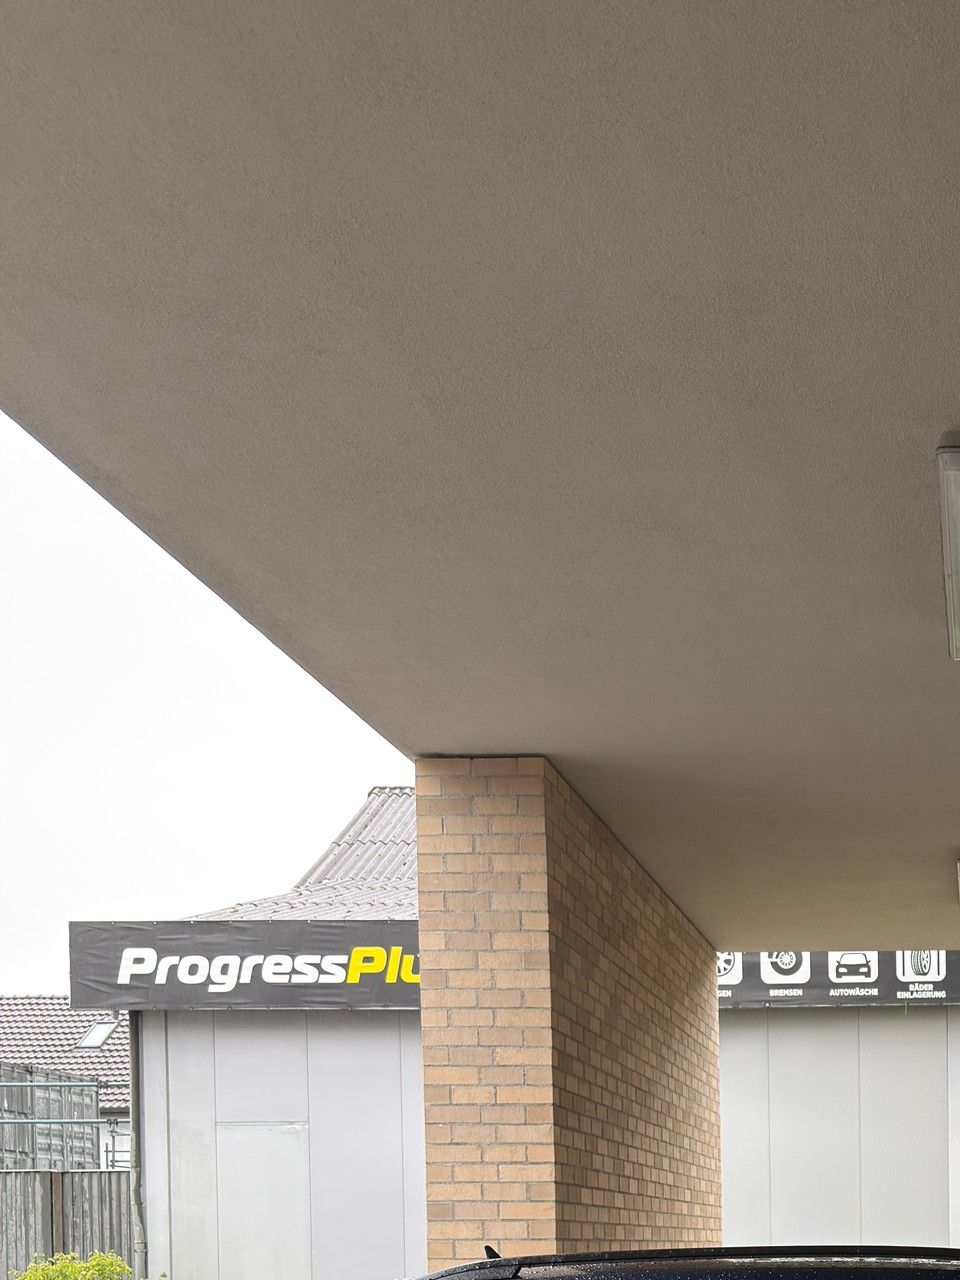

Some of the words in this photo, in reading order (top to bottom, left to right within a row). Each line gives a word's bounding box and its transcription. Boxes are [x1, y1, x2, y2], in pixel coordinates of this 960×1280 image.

[117, 946, 421, 993] ProgressPlu
[909, 983, 934, 991] RÄDER
[718, 989, 732, 998] GEN
[829, 987, 879, 997] AUTOWÄSCHE
[897, 990, 947, 999] EINLAGERUNG
